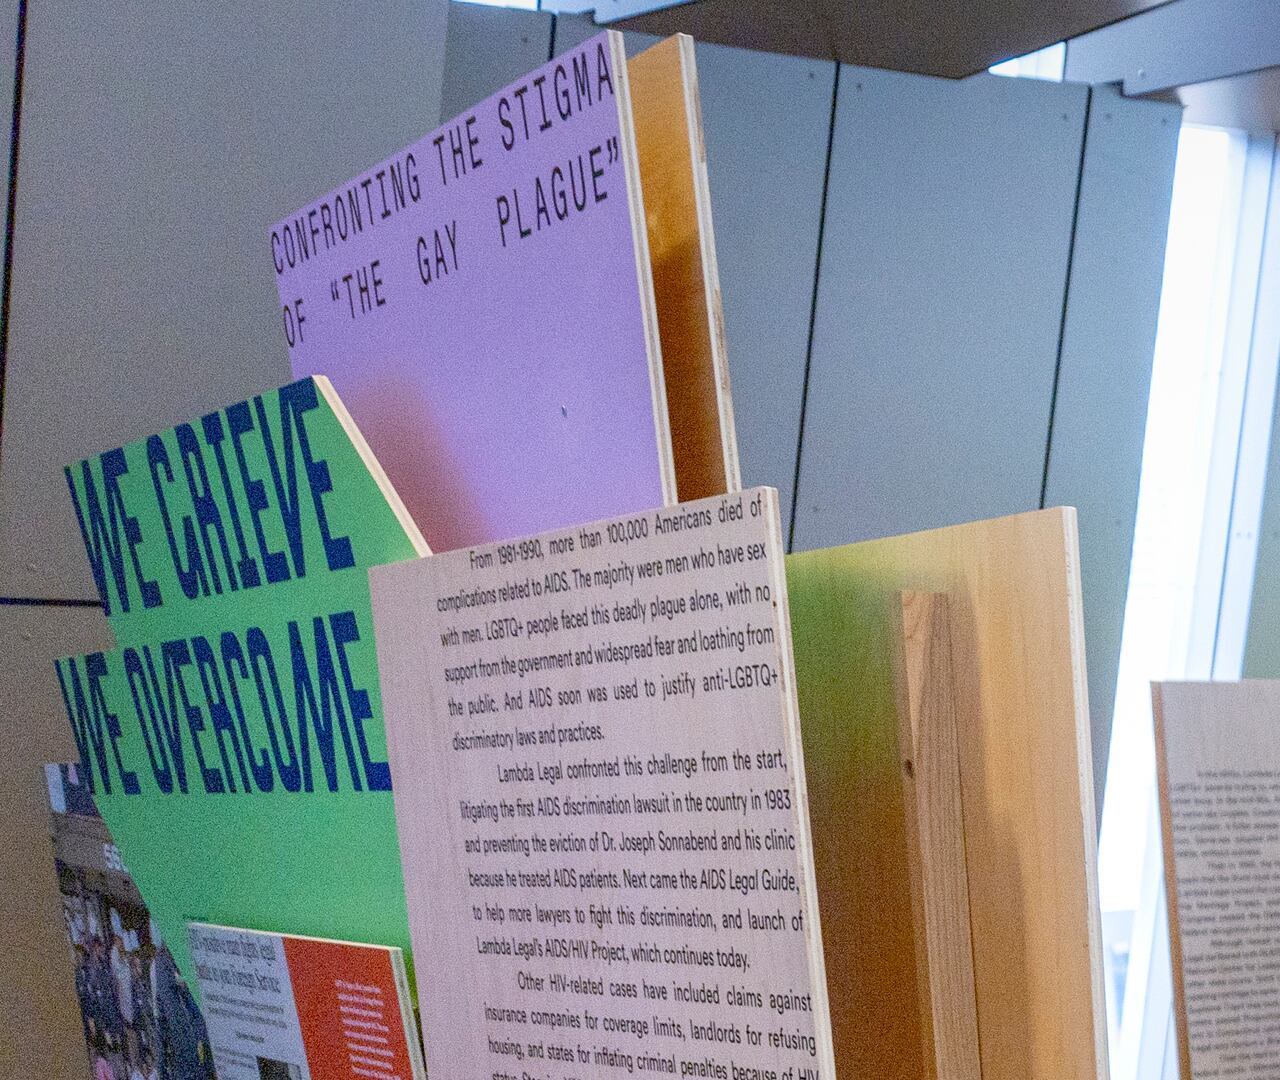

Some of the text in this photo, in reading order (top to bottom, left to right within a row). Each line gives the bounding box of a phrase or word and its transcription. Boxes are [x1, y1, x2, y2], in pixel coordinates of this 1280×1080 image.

[270, 42, 615, 276] CONFRONTING THE STIGMA
[282, 297, 307, 349] OF
[415, 219, 459, 287] GAY
[64, 376, 355, 616] WE GRIEVE
[468, 549, 494, 570] From
[548, 536, 575, 555] more
[578, 528, 603, 550] than
[605, 516, 649, 544] 100,000
[654, 507, 713, 535] Americans
[717, 496, 744, 524] died
[749, 491, 763, 519] of
[54, 611, 392, 795] WE OVERCOME
[496, 748, 788, 786] Lambda Legal confronted this challenge from the start,
[516, 970, 813, 1016] Other HIV-related cases have included claims against
